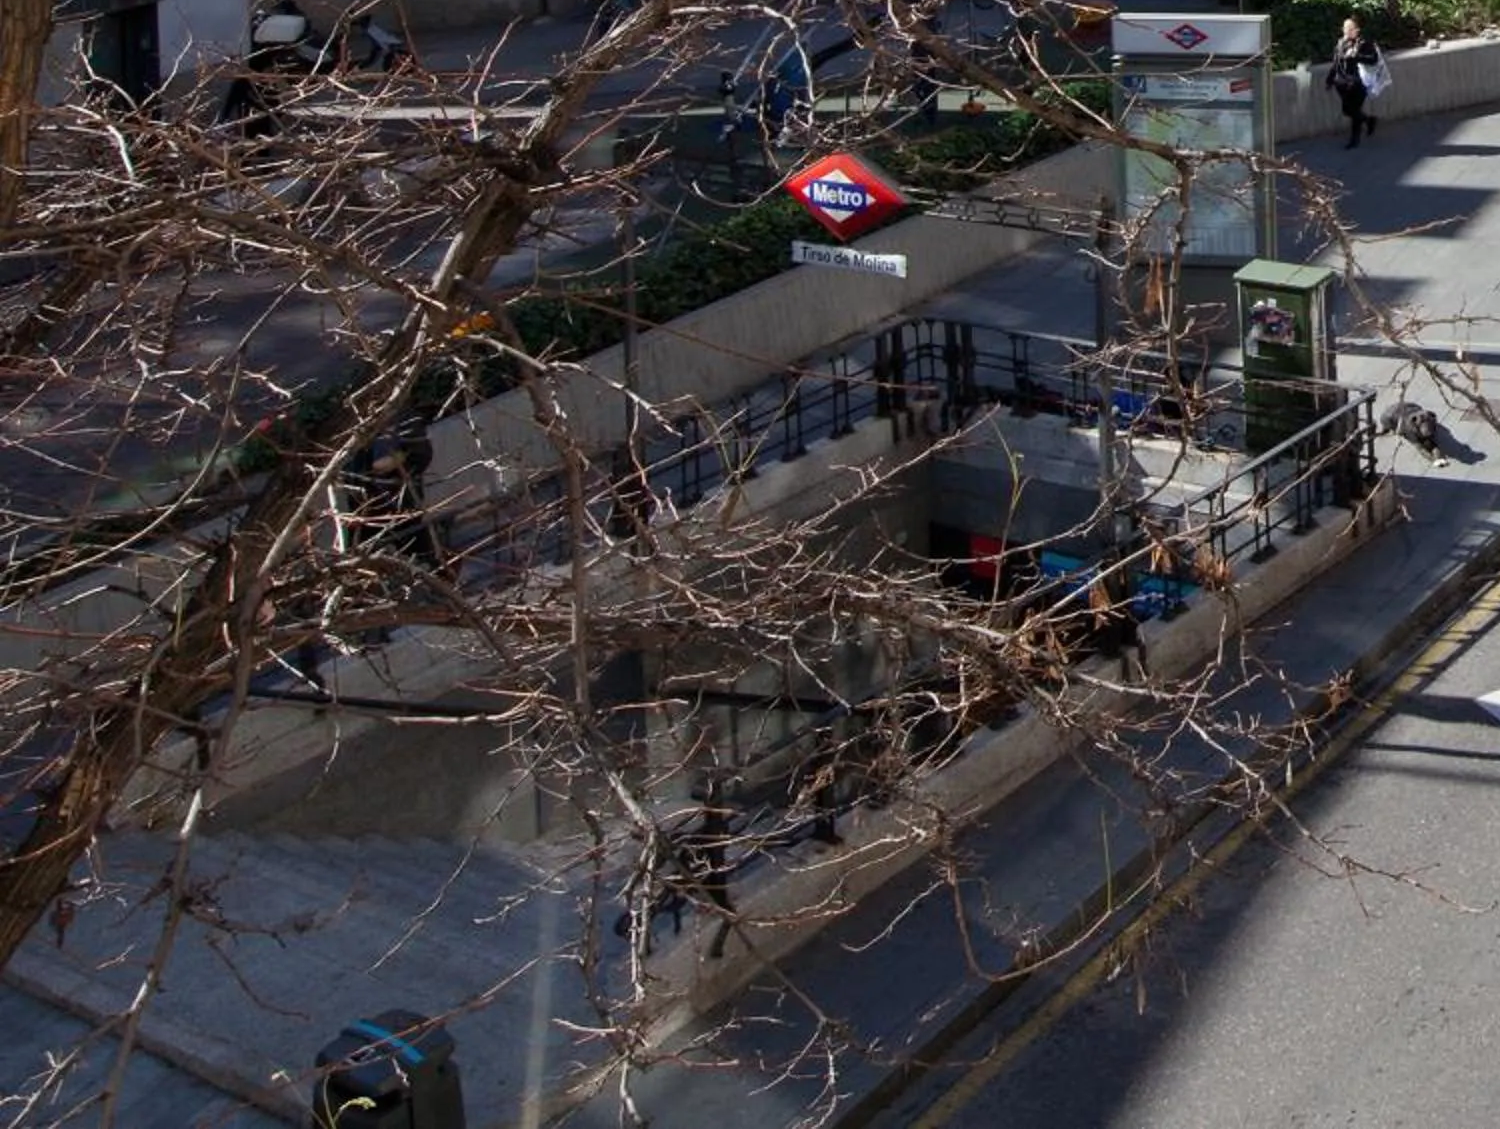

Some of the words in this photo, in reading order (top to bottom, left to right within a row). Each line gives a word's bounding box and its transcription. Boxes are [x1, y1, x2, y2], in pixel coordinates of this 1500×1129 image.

[812, 182, 863, 207] Metro
[802, 246, 831, 263] Tirso
[833, 252, 850, 267] de
[853, 254, 897, 273] Molina
